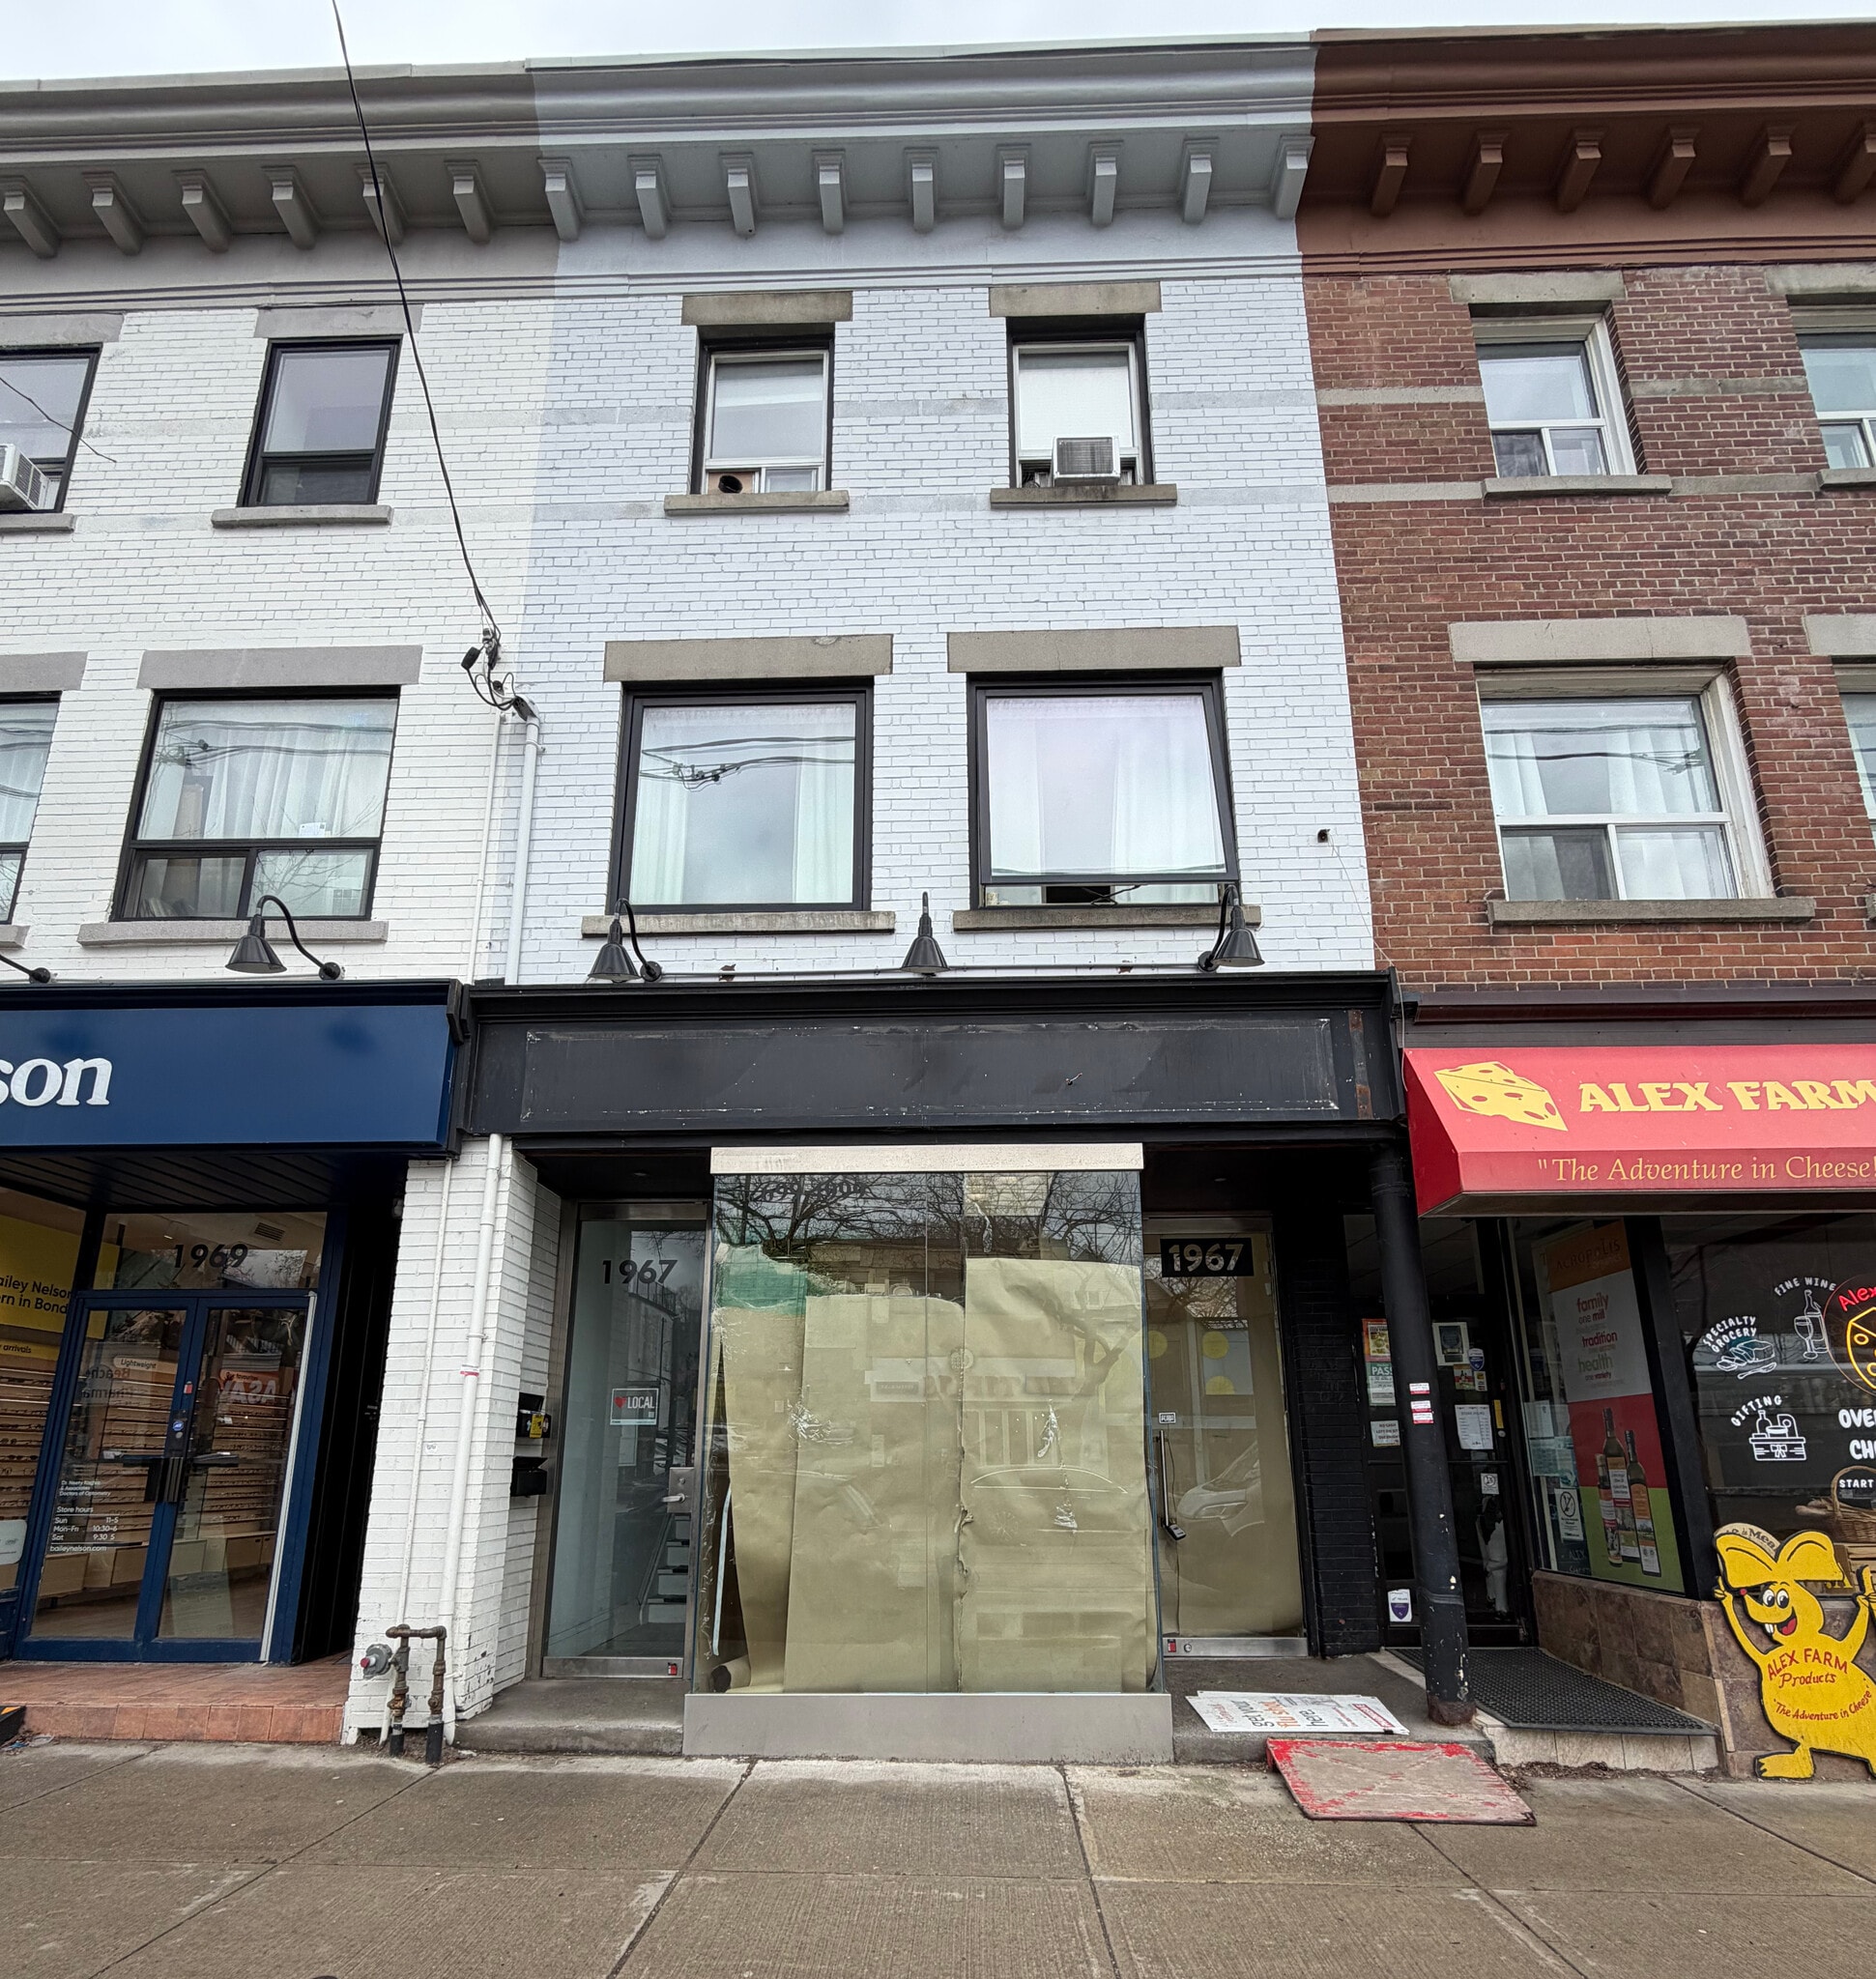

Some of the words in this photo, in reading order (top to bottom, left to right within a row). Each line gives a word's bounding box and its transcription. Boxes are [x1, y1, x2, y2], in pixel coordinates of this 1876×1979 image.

[1578, 1080, 1723, 1112] ALEX
[1726, 1079, 1876, 1112] FARM
[1607, 1158, 1743, 1182] Adventure
[1750, 1158, 1776, 1180] in
[174, 1243, 248, 1269] 1969
[1169, 1244, 1244, 1272] 1967
[602, 1259, 678, 1284] 1967
[1774, 1277, 1801, 1296] FINE
[1804, 1276, 1836, 1291] WINE
[0, 1294, 14, 1305] rn
[18, 1294, 31, 1308] in
[1576, 1292, 1609, 1313] family
[1838, 1286, 1876, 1311] Alex
[1578, 1314, 1591, 1325] one
[1582, 1331, 1618, 1348] tradition
[1702, 1315, 1756, 1346] SPECIALTY
[1712, 1327, 1757, 1353] GROCERY
[120, 1359, 157, 1369] Lightweight
[1577, 1354, 1614, 1373] health
[627, 1396, 654, 1409] LOCAL
[1730, 1394, 1782, 1427] GIFTING
[1849, 1439, 1876, 1460] CH
[1838, 1479, 1874, 1488] START
[1768, 1649, 1800, 1680] ALEX
[1804, 1648, 1847, 1674] FARM
[1778, 1672, 1836, 1688] Products
[1792, 1708, 1839, 1720] Adventure
[1840, 1708, 1849, 1718] in
